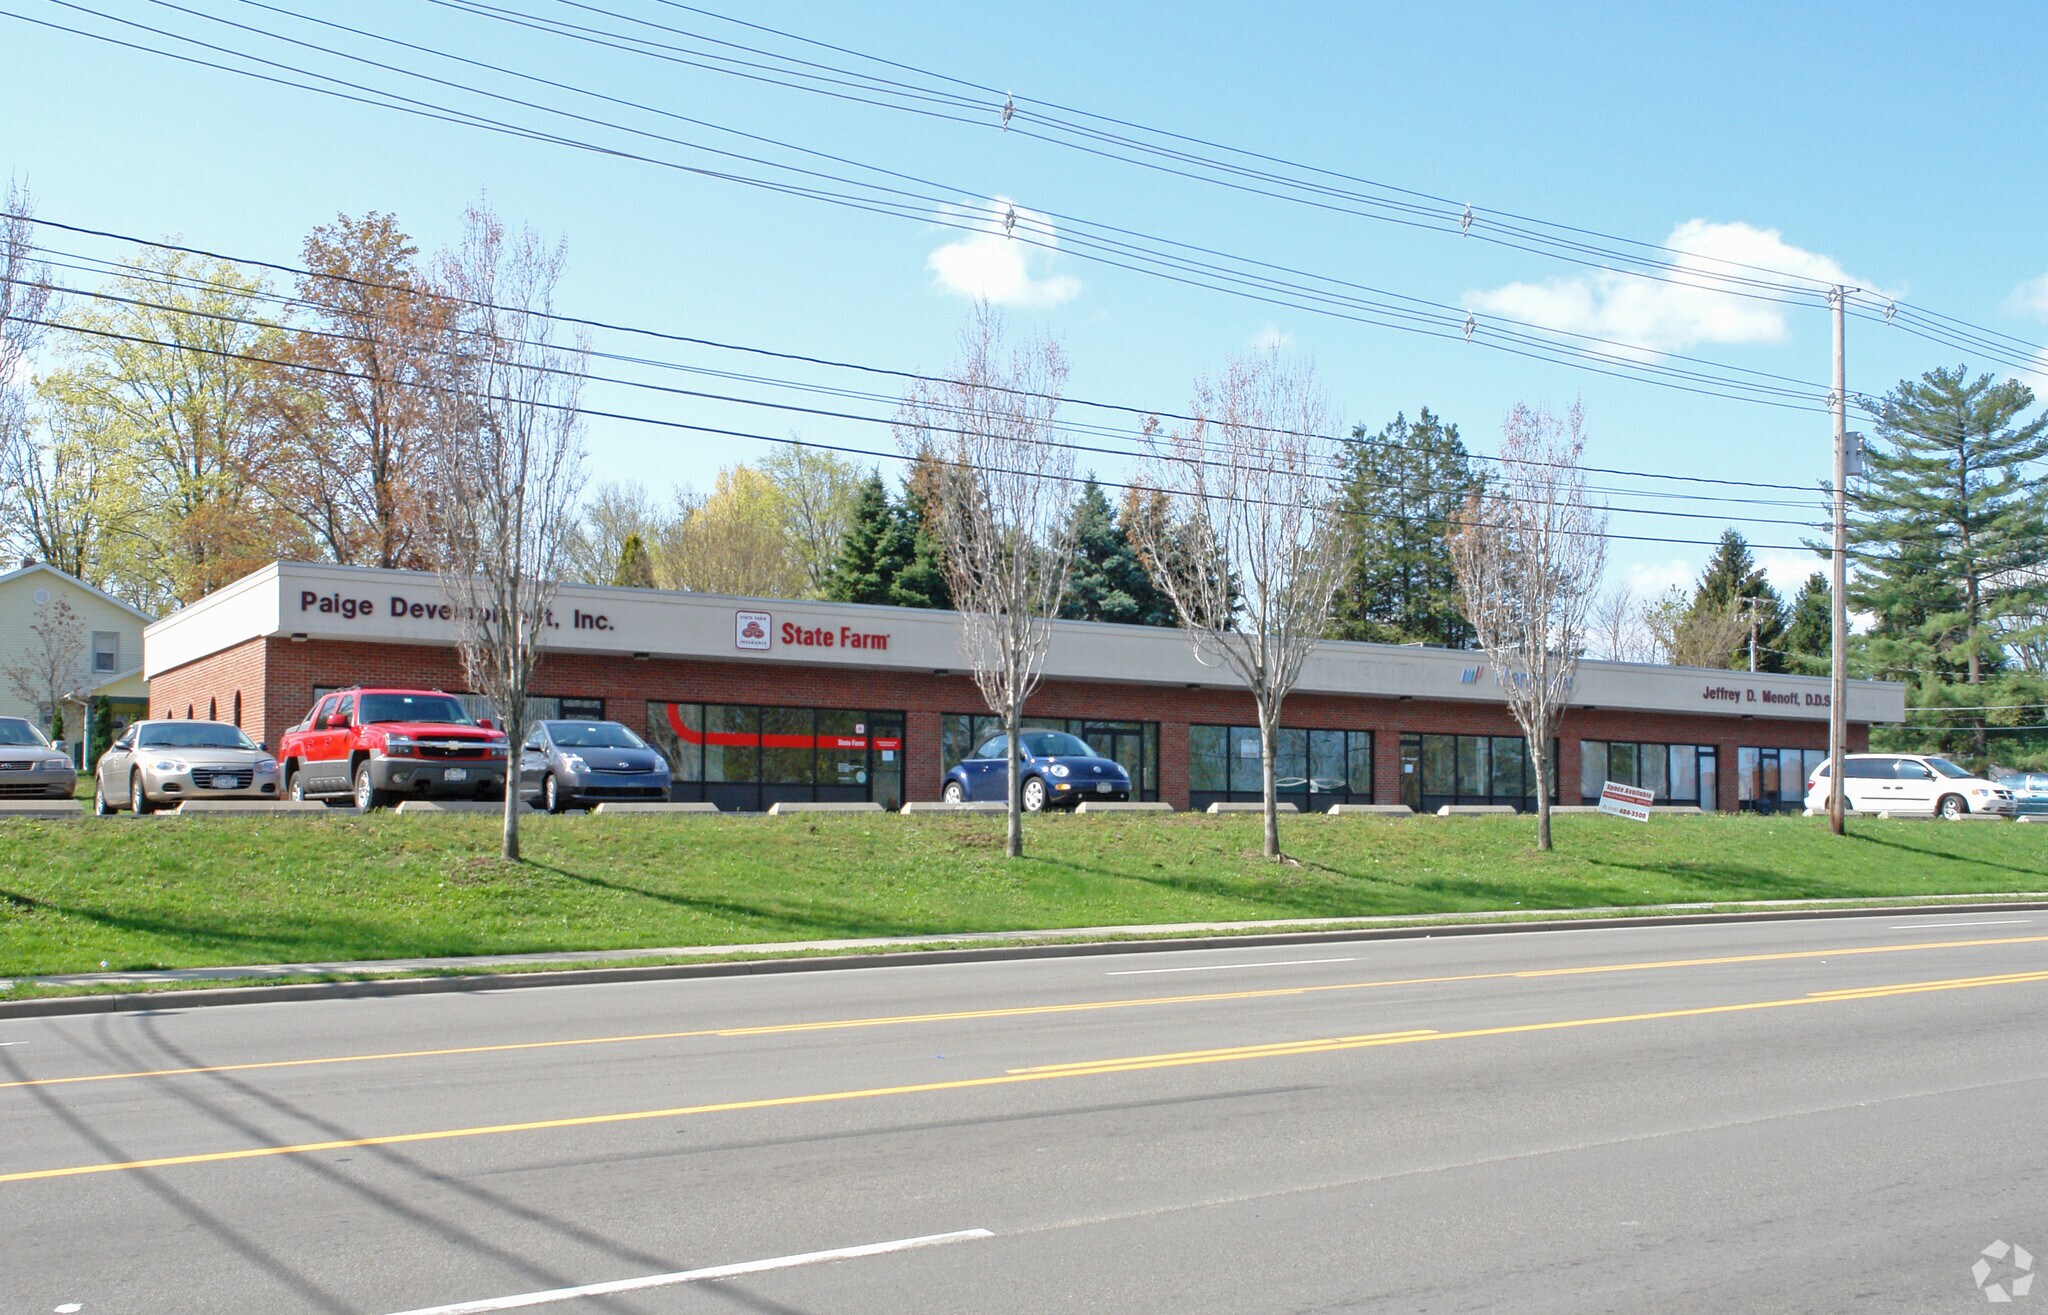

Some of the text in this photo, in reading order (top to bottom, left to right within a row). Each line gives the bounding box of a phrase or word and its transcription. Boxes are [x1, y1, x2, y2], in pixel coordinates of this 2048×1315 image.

[301, 591, 374, 619] Paige
[574, 609, 614, 631] Inc.
[781, 622, 888, 650] State Farm
[1703, 686, 1741, 704] Jeffrey
[1746, 688, 1757, 703] D.
[1762, 690, 1800, 707] Menoff,
[1607, 784, 1651, 798] Space Available
